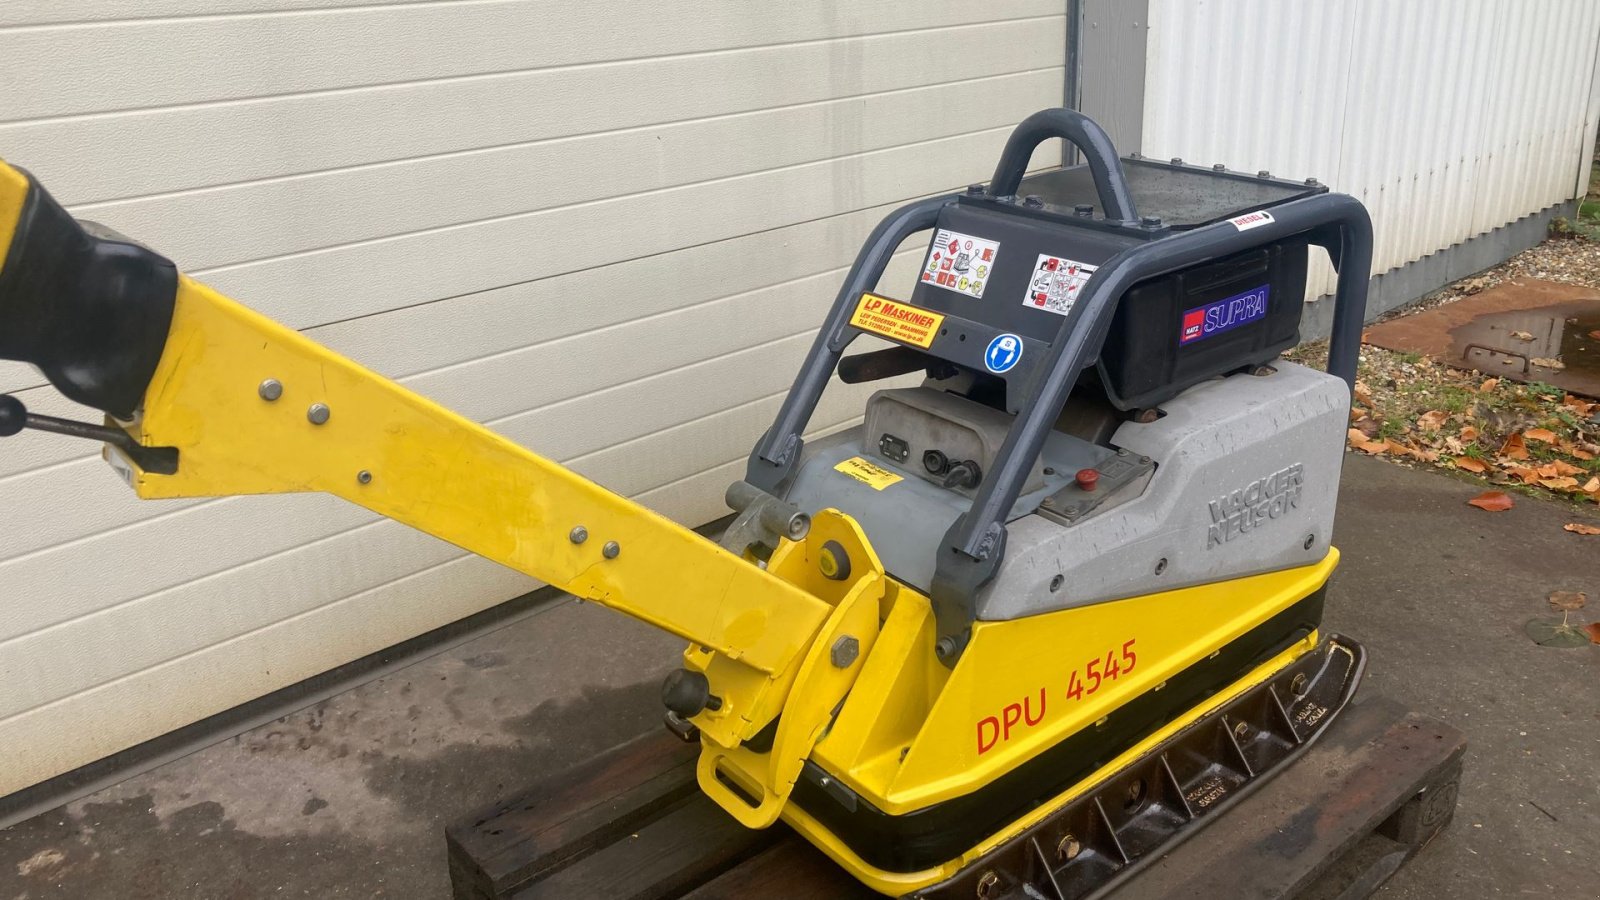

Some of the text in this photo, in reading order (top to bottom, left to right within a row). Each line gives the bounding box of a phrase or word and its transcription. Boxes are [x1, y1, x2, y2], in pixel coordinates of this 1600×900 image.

[1234, 214, 1263, 226] DIESEL
[864, 299, 934, 327] LP MASKINER
[1204, 291, 1264, 333] SUPRA
[1207, 484, 1303, 550] NEUSON
[1208, 462, 1304, 524] WACKER
[977, 639, 1136, 755] DPU 4545
